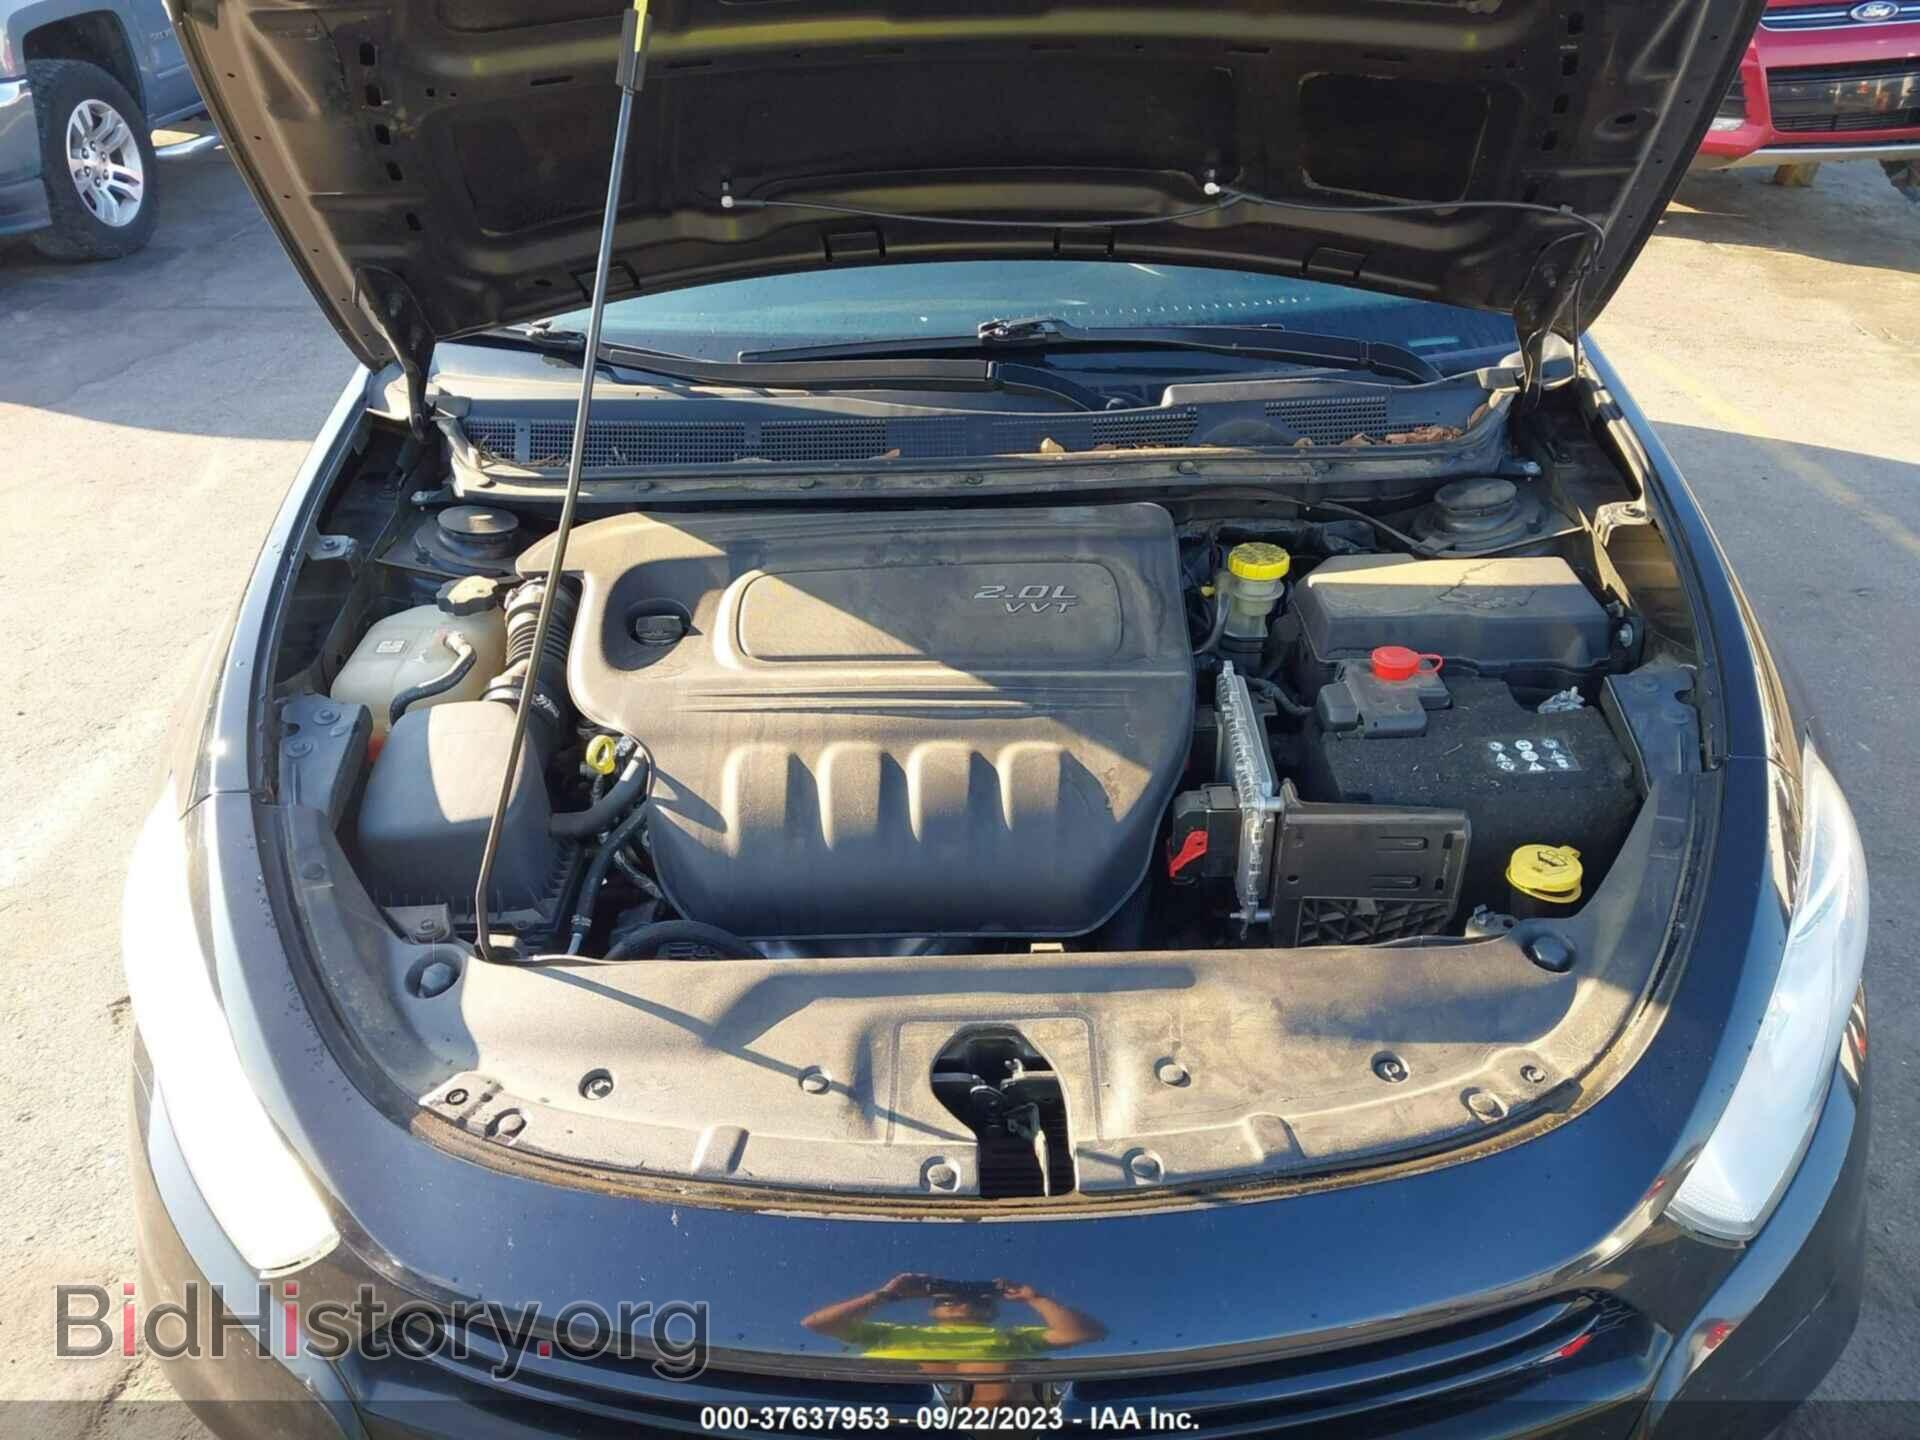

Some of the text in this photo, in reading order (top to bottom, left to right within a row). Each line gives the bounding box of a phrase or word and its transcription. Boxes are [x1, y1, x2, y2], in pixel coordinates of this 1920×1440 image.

[1862, 4, 1891, 17] Ford
[974, 585, 1078, 599] 2.0L
[1005, 601, 1077, 614] VVT
